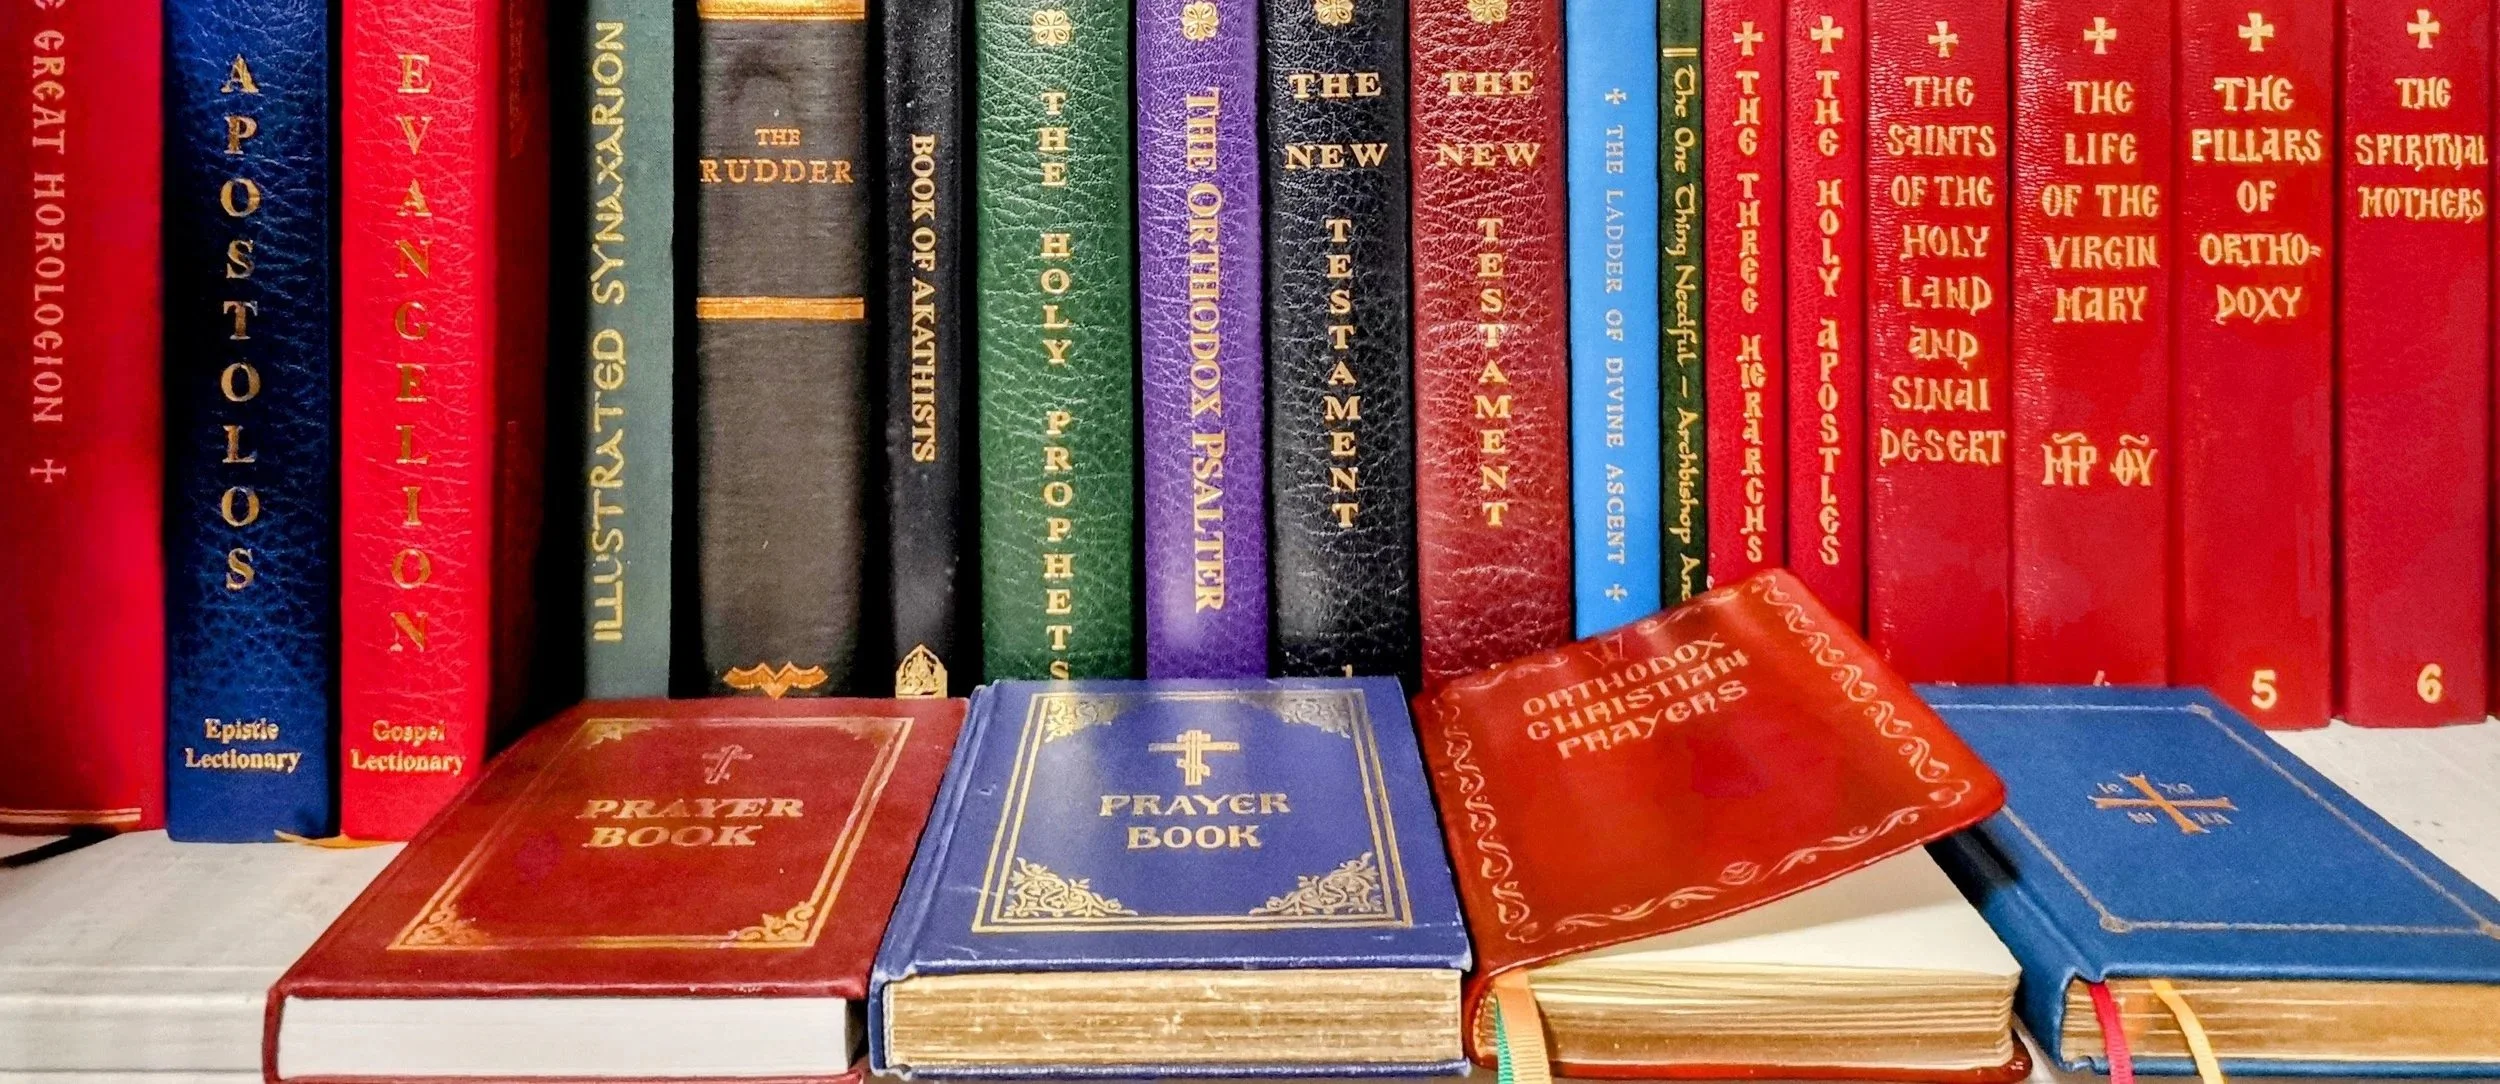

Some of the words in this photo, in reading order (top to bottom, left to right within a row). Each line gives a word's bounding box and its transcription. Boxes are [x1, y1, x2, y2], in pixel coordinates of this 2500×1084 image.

[32, 29, 66, 153] GREAT
[1288, 72, 1382, 98] THE
[1444, 72, 1534, 97] THE
[1672, 64, 1696, 118] The
[1904, 76, 1975, 108] THE
[2067, 80, 2135, 115] THE
[2213, 76, 2295, 112] THE
[2394, 76, 2452, 110] THE
[1185, 86, 1219, 171] THE
[1734, 70, 1761, 155] THE
[1814, 70, 1842, 157] THE
[755, 128, 800, 147] THE
[1040, 91, 1068, 188] THE
[1284, 143, 1388, 169] NEW
[1436, 143, 1541, 167] NEW
[1605, 125, 1625, 174] THE
[1674, 127, 1697, 174] One
[1886, 124, 1997, 157] SAINTS
[2064, 133, 2137, 166] LIFE
[2191, 128, 2323, 167] PILLARS
[2354, 132, 2489, 172] SPIRITUAL
[591, 21, 625, 305] SYNAXARION
[700, 159, 853, 184] RUDDER
[911, 133, 936, 221] BOOK
[1891, 174, 1927, 206] OF
[1934, 174, 1995, 207] THE
[2041, 185, 2082, 218] OF
[2095, 185, 2160, 218] THE
[2236, 180, 2277, 212] OF
[2356, 185, 2486, 224] MOTHERS
[1663, 184, 1697, 257] Thing
[1816, 179, 1844, 298] HOLY
[911, 228, 936, 272] OF
[1605, 190, 1625, 294] LADDER
[1736, 173, 1761, 314] THREE
[1900, 225, 1990, 259] HOLY
[2043, 235, 2160, 269] VIRGIN
[32, 172, 66, 424] HOROLOGION
[1041, 233, 1071, 365] HOLY
[1186, 181, 1223, 419] ORTHODOX
[1665, 265, 1698, 367] Needful
[1901, 276, 1993, 314] LAND
[2052, 286, 2148, 323] MARY
[2213, 284, 2303, 325] DOXY
[219, 54, 260, 590] APOSTOLOS
[1605, 309, 1625, 342] OF
[390, 53, 433, 652] EVANGELION
[1908, 326, 1978, 369] AND
[911, 276, 936, 463] AKATHISTS
[1324, 218, 1362, 528] TESTAMENT
[1474, 217, 1512, 527] TESTAMENT
[1605, 358, 1625, 448] DIVINE
[1890, 377, 1990, 411] SINAI
[1736, 334, 1767, 563] HIERARCHS
[1816, 317, 1844, 566] APOSTLES
[1880, 430, 2006, 465] DESERT
[591, 328, 624, 641] ILLUSTRATED
[1669, 407, 1699, 543] Archbishop
[1192, 429, 1225, 613] PSALTER
[1605, 463, 1625, 565] ASCENT
[1044, 410, 1073, 681] PROPHETS
[1522, 632, 1725, 716] ORTHODOX
[1526, 648, 1750, 740] CHRISTIAN
[2252, 670, 2277, 709] 5
[2417, 664, 2443, 702] 6
[204, 718, 280, 744] Epistle
[372, 719, 446, 747] Gospel
[1556, 680, 1748, 760] PRAYERS
[185, 748, 302, 773] Lectionary
[350, 748, 466, 776] Lectionary
[575, 798, 804, 819] PRAYER
[1099, 792, 1292, 817] PRAYER
[582, 825, 763, 847] BOOK
[1126, 824, 1263, 849] BOOK
